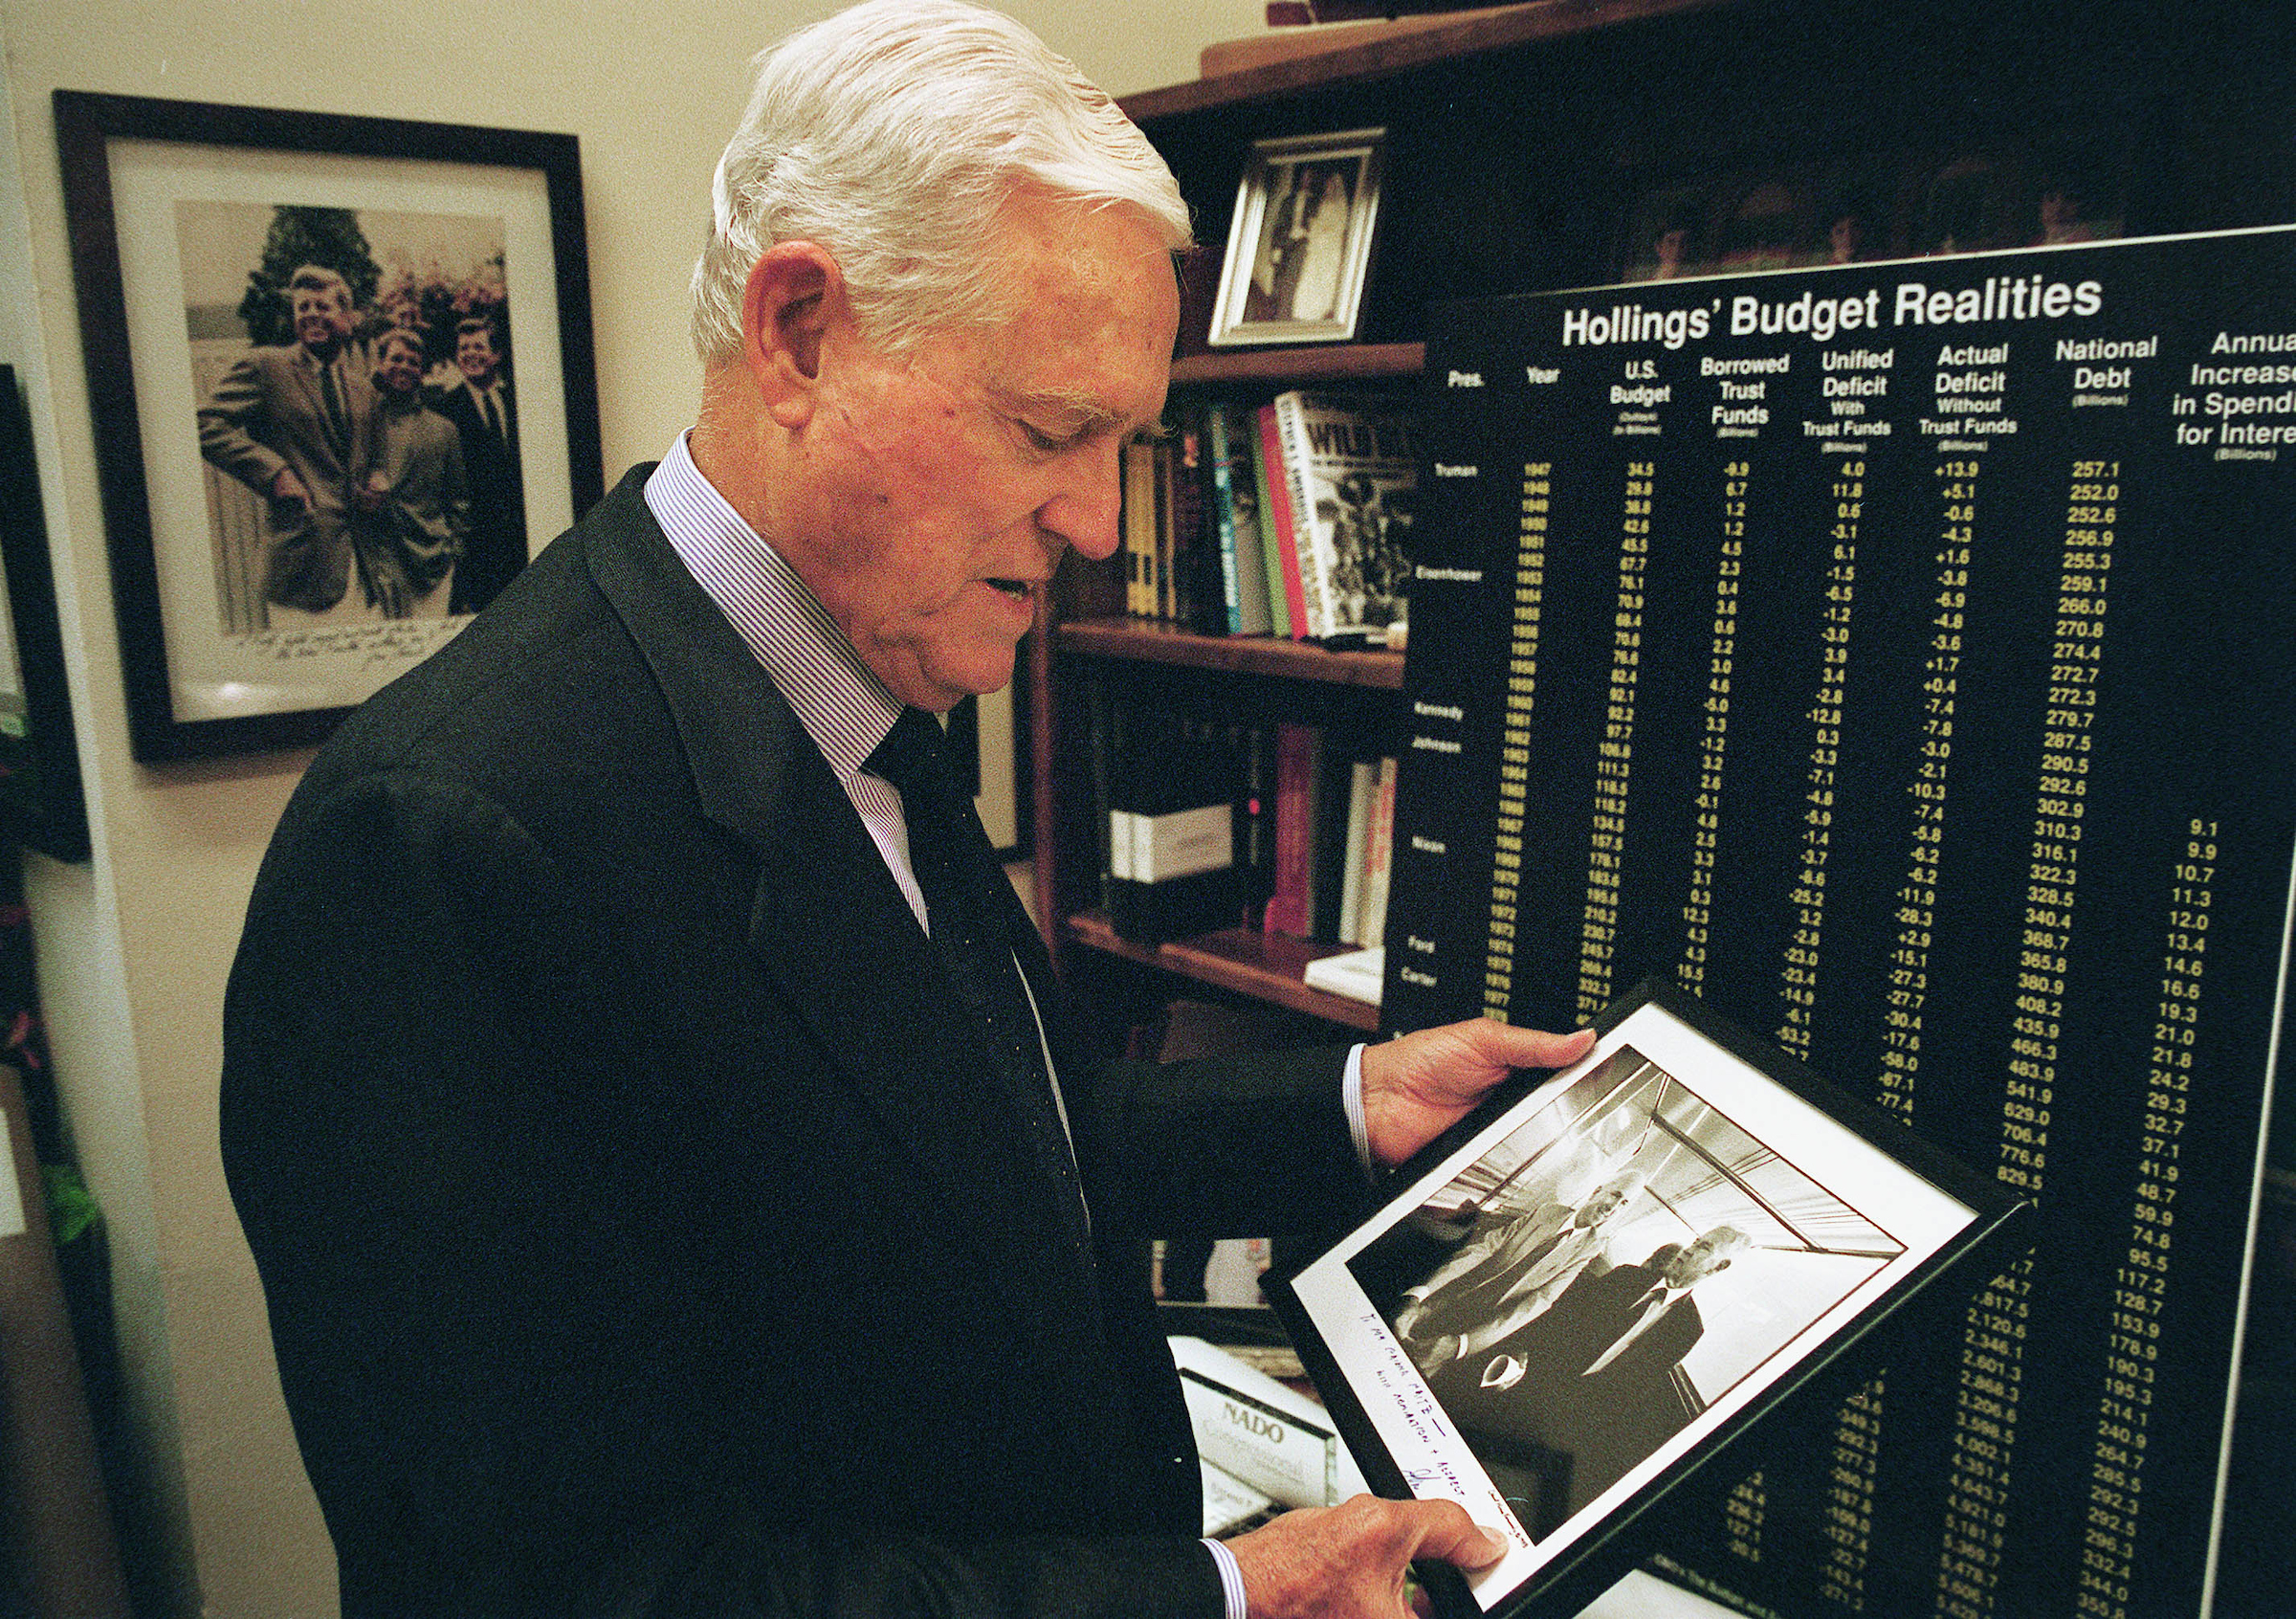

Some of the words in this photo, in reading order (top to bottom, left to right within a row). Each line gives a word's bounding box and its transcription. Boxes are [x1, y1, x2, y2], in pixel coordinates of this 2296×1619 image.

[1731, 289, 1881, 342] Budget
[1894, 274, 2102, 325] Realities
[1937, 343, 2009, 366] Actual
[2056, 336, 2157, 361] National
[1701, 354, 1790, 376] Borrowed
[1822, 348, 1894, 371] Unified
[1527, 366, 1560, 384] Year
[1625, 360, 1658, 380] U.S.
[2074, 366, 2131, 389] Debt
[2191, 364, 2296, 385] Increas
[1720, 381, 1766, 400] Trust
[1822, 375, 1888, 397] Deficit
[1935, 371, 2006, 393] Deficit
[1610, 385, 1671, 408] Budget
[1937, 397, 2002, 413] Without
[2173, 393, 2197, 415] in
[1711, 405, 1769, 425] Funds
[1831, 401, 1865, 415] With
[1802, 421, 1840, 436] Trust
[1843, 420, 1891, 435] Funds
[1919, 418, 1960, 434] Trust
[1964, 417, 2018, 434] Funds
[2177, 423, 2214, 445] for
[2215, 448, 2276, 460] (Billions)
[1842, 461, 1865, 477] 4.0
[1935, 461, 1978, 477] +13.9
[2072, 461, 2119, 477] 257.1
[1943, 483, 1975, 499] +5.1
[2070, 484, 2119, 500] 252.0
[1944, 505, 1974, 521] -0.6
[2067, 506, 2116, 523] 252.6
[1942, 527, 1972, 543] -4.3
[2065, 529, 2113, 546] 256.9
[1936, 549, 1970, 565] +1.6
[2063, 552, 2110, 569] 255.3
[2061, 575, 2107, 592] 259.1
[1823, 608, 1850, 622] -1.2
[2058, 597, 2107, 615] 266.0
[2056, 620, 2104, 638] 270.8
[2053, 643, 2100, 660] 274.4
[1926, 657, 1959, 671] +1.7
[2051, 665, 2099, 682] 272.7
[1924, 677, 1956, 693] +0.4
[2049, 687, 2096, 706] 272.3
[1925, 699, 1954, 714] -7.4
[2046, 709, 2094, 727] 279.7
[1923, 720, 1952, 737] -7.8
[1921, 742, 1951, 758] -3.0
[2044, 732, 2090, 751] 287.5
[1919, 763, 1946, 778] -2.1
[2042, 754, 2088, 774] 290.5
[1908, 783, 1945, 800] -10.3
[2040, 776, 2086, 796] 292.6
[1915, 805, 1943, 821] -7.4
[2038, 798, 2084, 818] 302.9
[2035, 820, 2081, 840] 310.3
[2191, 819, 2217, 835] 9.1
[2033, 842, 2076, 862] 316.1
[2189, 842, 2217, 860] 9.9
[2030, 864, 2076, 885] 322.3
[2176, 865, 2214, 882] 10.7
[2028, 886, 2073, 907] 328.5
[2174, 888, 2211, 907] 11.3
[2025, 908, 2070, 928] 340.4
[2171, 911, 2208, 930] 12.0
[2168, 934, 2204, 952] 13.4
[2166, 957, 2202, 976] 14.6
[1888, 990, 1924, 1008] -27.7
[2163, 980, 2199, 999] 16.6
[2017, 995, 2062, 1017] 408.2
[2160, 1003, 2197, 1023] 19.3
[2155, 1024, 2195, 1045] 21.0
[2152, 1047, 2192, 1068] 21.8
[2151, 1070, 2189, 1091] 24.2
[2148, 1092, 2186, 1114] 29.3
[2146, 1114, 2183, 1134] 32.7
[2143, 1137, 2178, 1157] 37.1
[2140, 1161, 2178, 1181] 41.9
[2119, 1269, 2165, 1294] 117.2
[1224, 1401, 1285, 1445] NADO
